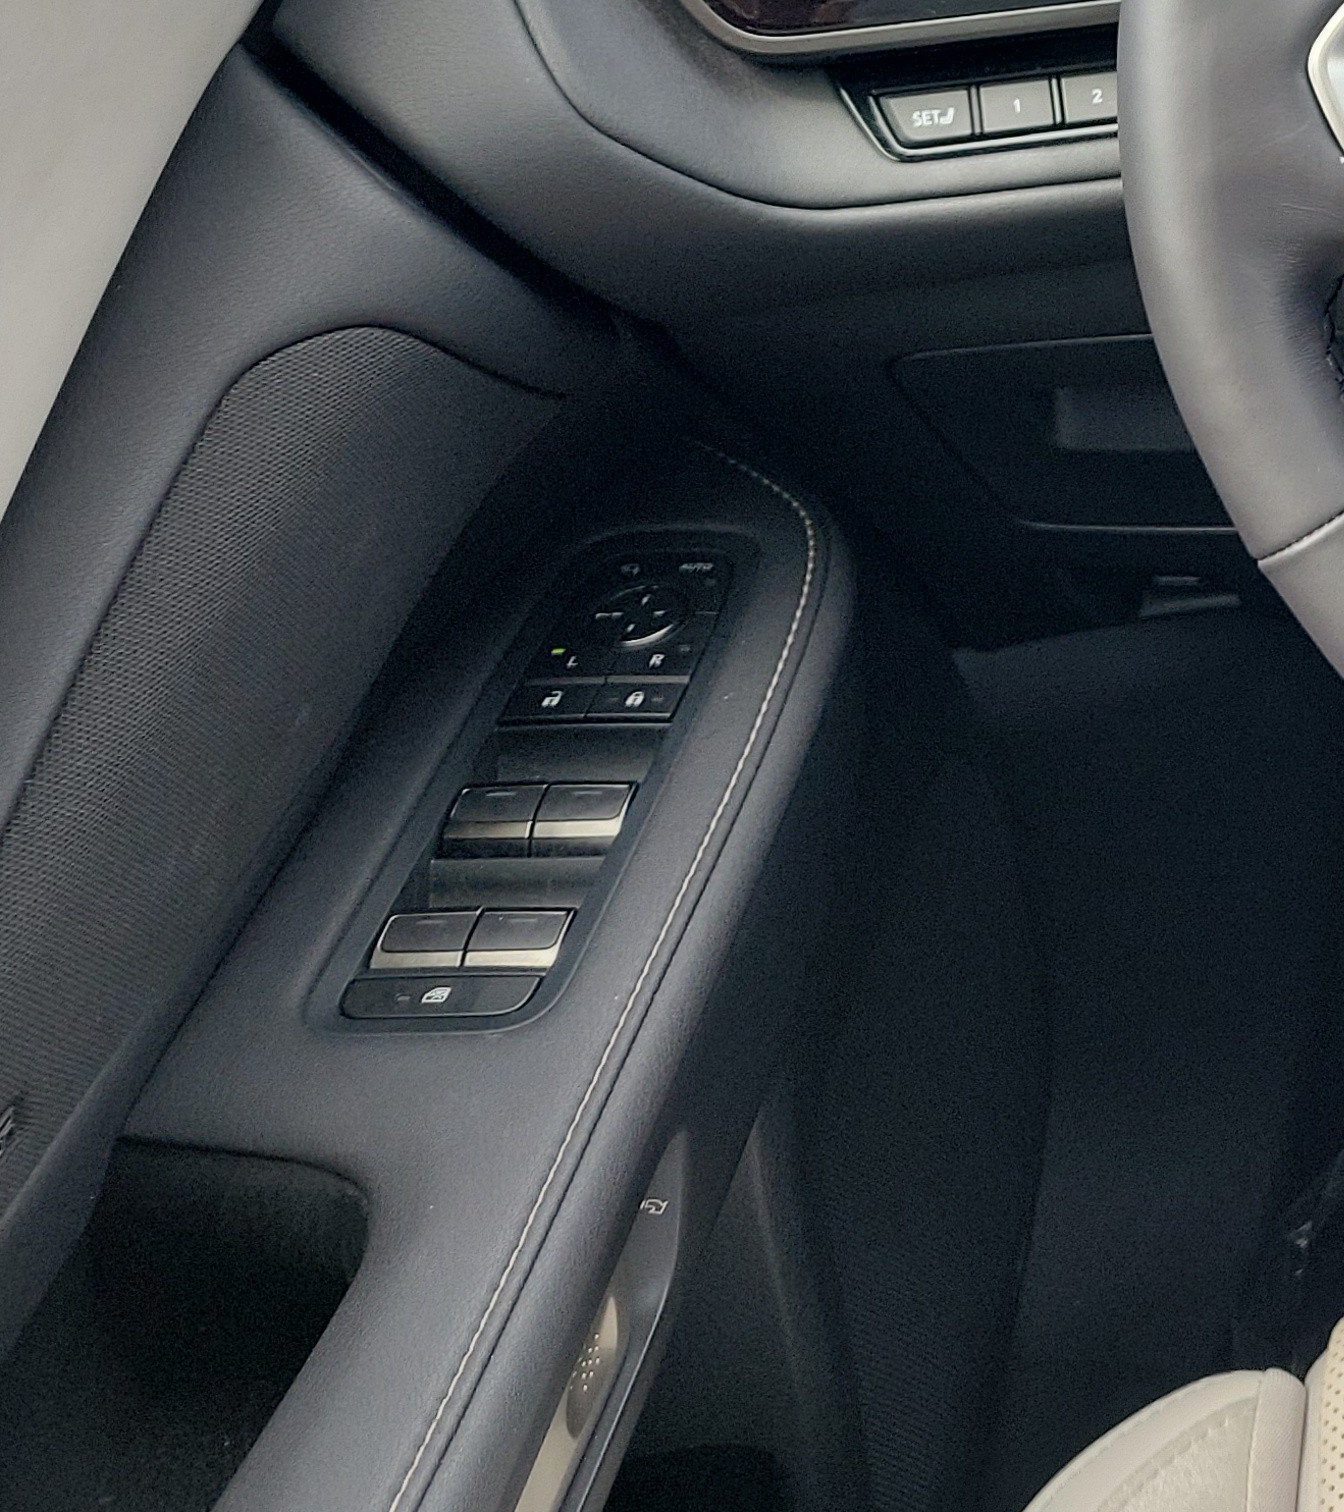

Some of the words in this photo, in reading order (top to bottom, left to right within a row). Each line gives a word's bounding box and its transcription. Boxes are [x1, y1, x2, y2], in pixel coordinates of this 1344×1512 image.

[1091, 89, 1103, 104] 2
[1013, 97, 1021, 113] 1
[911, 110, 940, 127] SET
